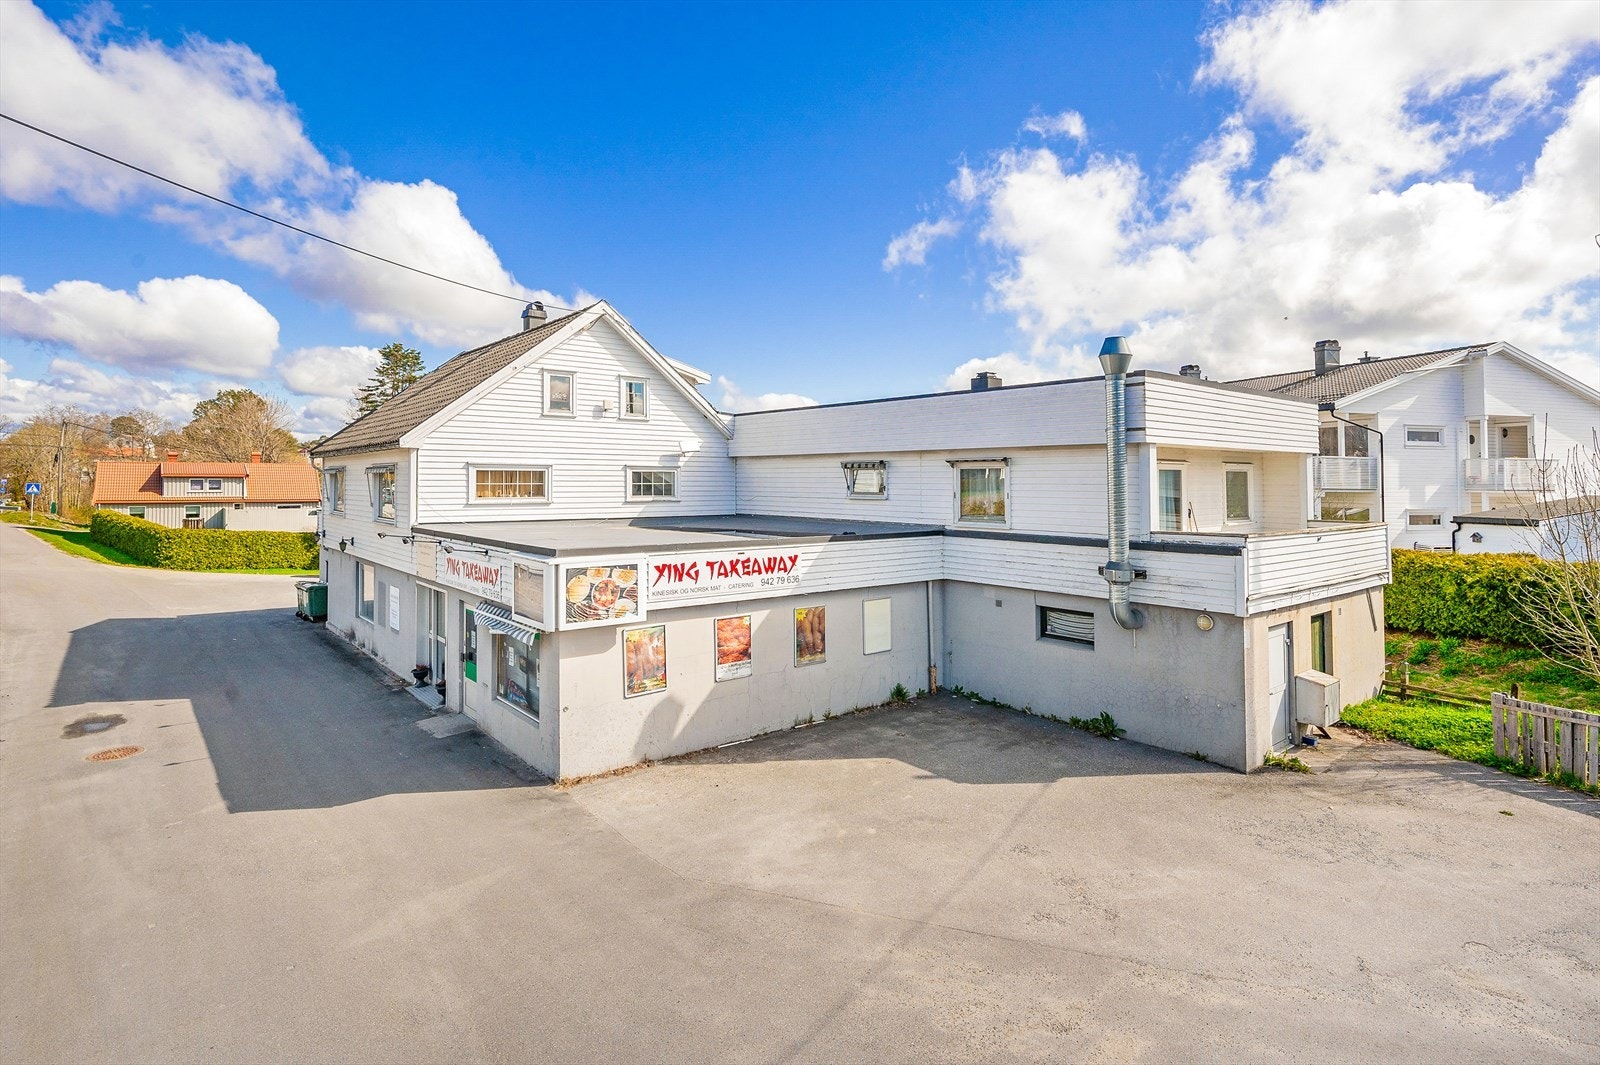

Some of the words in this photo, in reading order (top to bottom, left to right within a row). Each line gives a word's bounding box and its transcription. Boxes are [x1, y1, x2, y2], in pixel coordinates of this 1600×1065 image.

[446, 557, 460, 576] YING
[461, 560, 499, 588] TAKEAWAY
[652, 561, 699, 587] YING
[706, 554, 799, 580] TAKEAWAY
[761, 577, 774, 587] 942
[776, 576, 786, 585] 79
[787, 575, 800, 584] 636
[652, 588, 679, 597] KINESISK
[680, 587, 689, 595] OG
[690, 586, 710, 594] NORSK
[710, 584, 721, 592] MAT
[728, 582, 754, 590] CATERING
